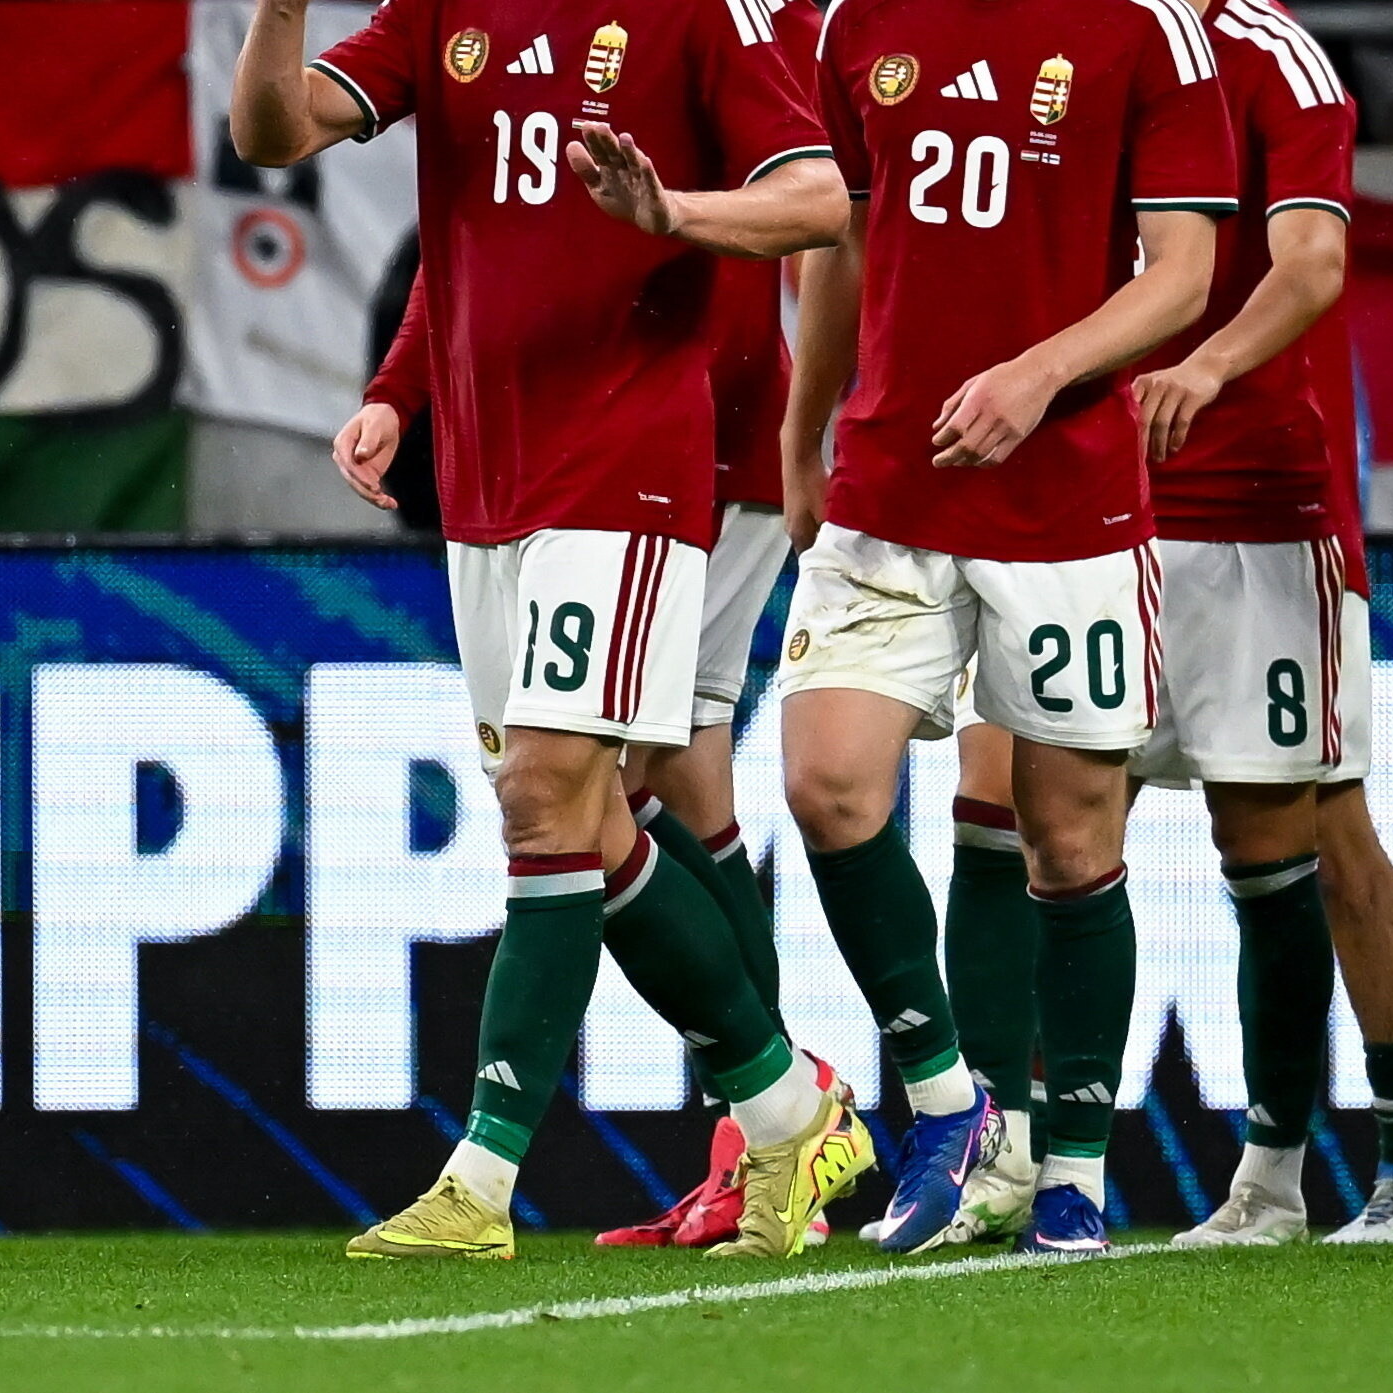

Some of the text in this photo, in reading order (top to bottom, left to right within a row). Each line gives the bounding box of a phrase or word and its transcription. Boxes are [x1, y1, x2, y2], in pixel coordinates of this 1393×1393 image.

[492, 109, 559, 205] 19
[908, 129, 1010, 228] 20
[522, 600, 595, 692] 19
[1028, 619, 1126, 713] 20
[1266, 658, 1308, 748] 8
